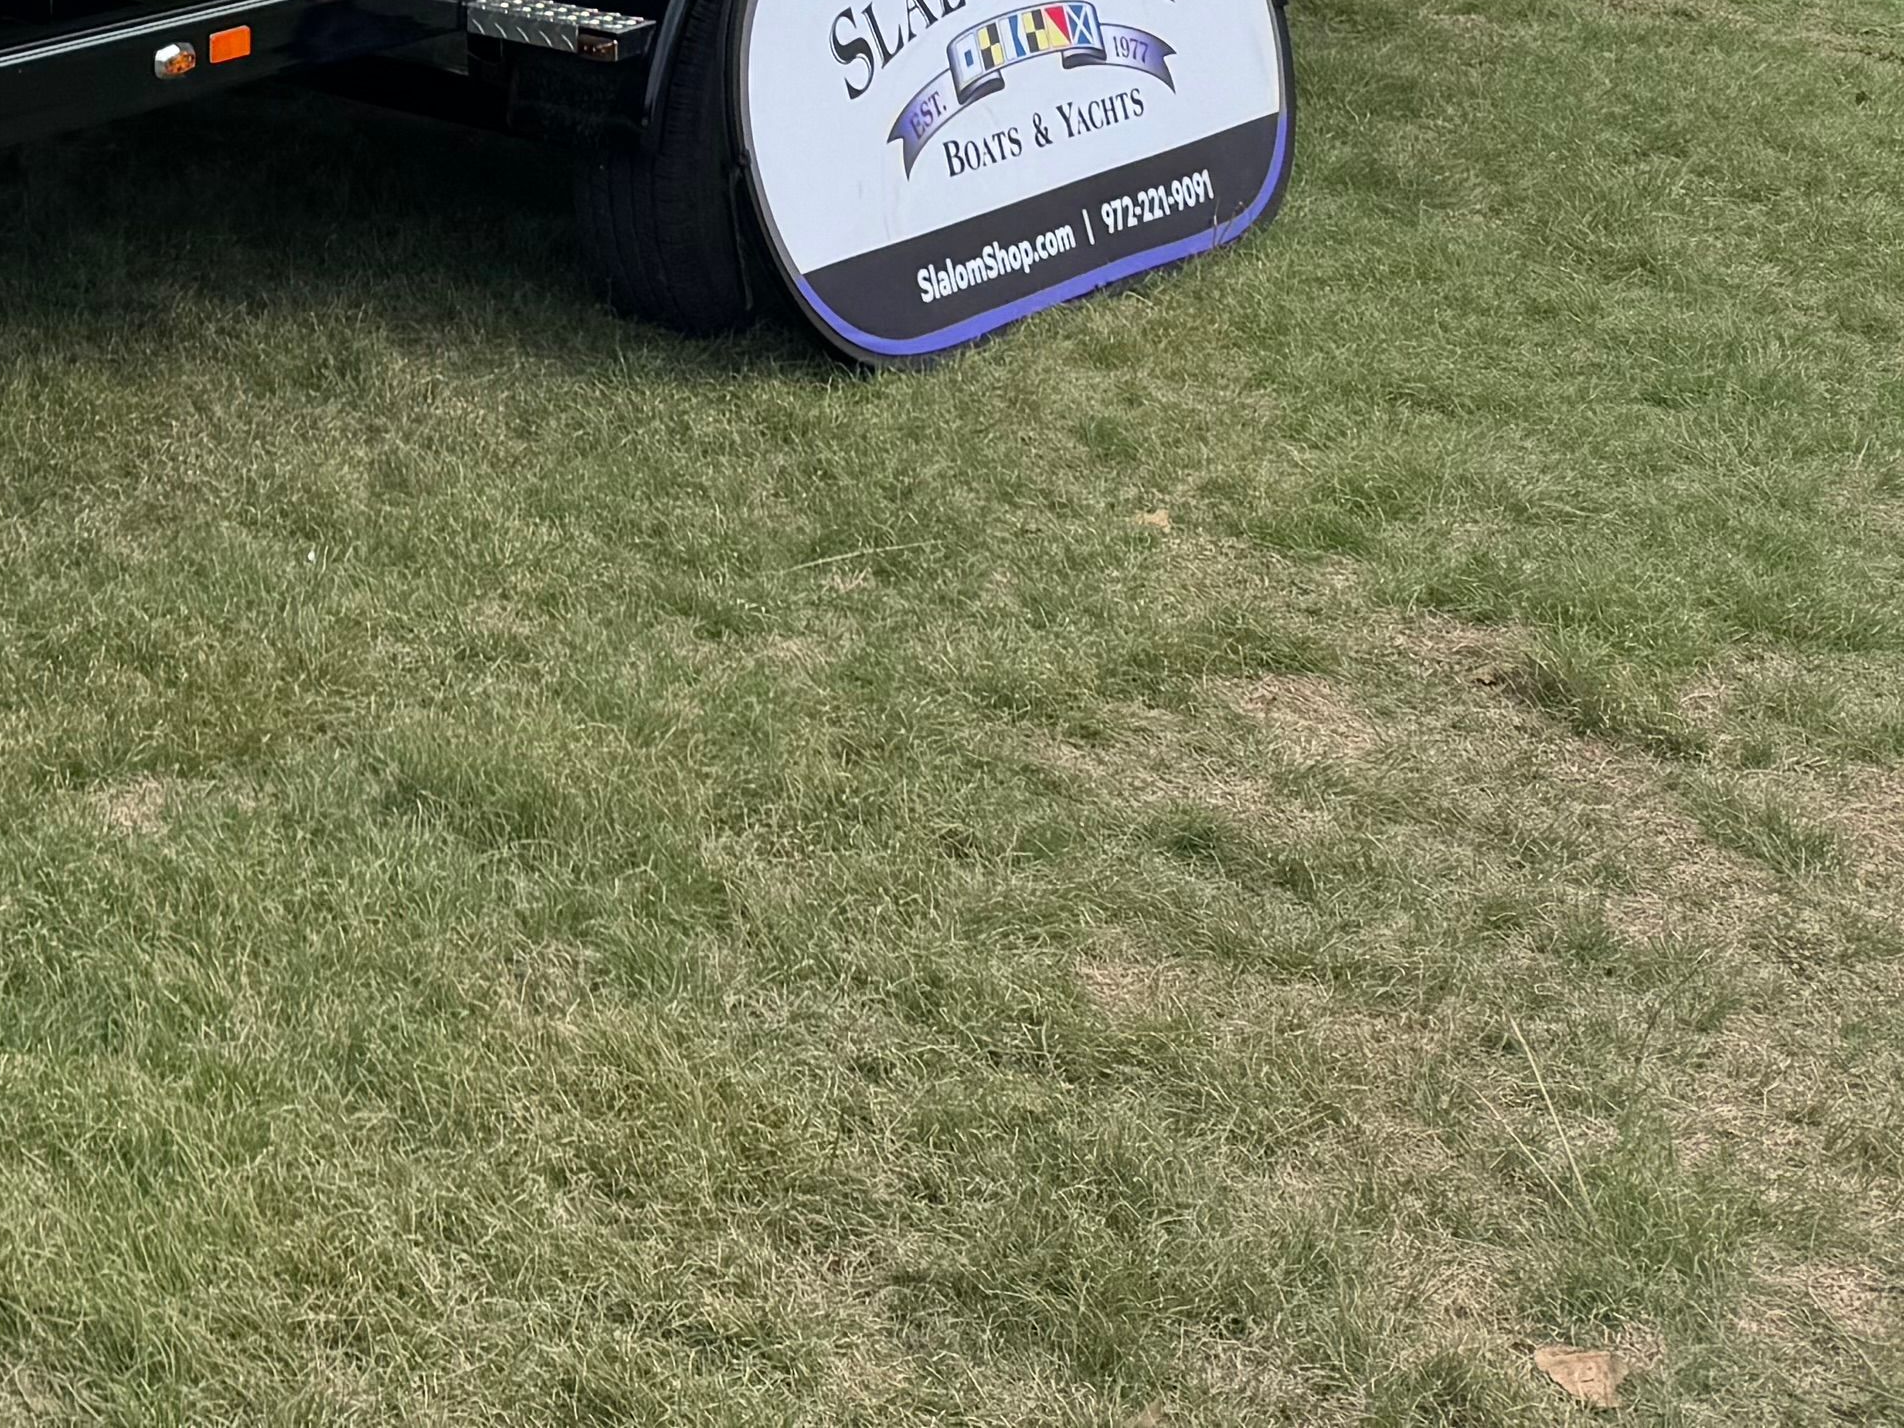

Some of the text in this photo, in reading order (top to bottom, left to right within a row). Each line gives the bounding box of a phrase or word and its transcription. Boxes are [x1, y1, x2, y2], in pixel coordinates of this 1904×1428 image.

[909, 36, 1149, 140] EST. 1977
[943, 88, 1144, 177] BOATS & YACHTS
[917, 224, 1076, 303] SlalomShop.com
[1101, 169, 1214, 234] 972-221-9091
